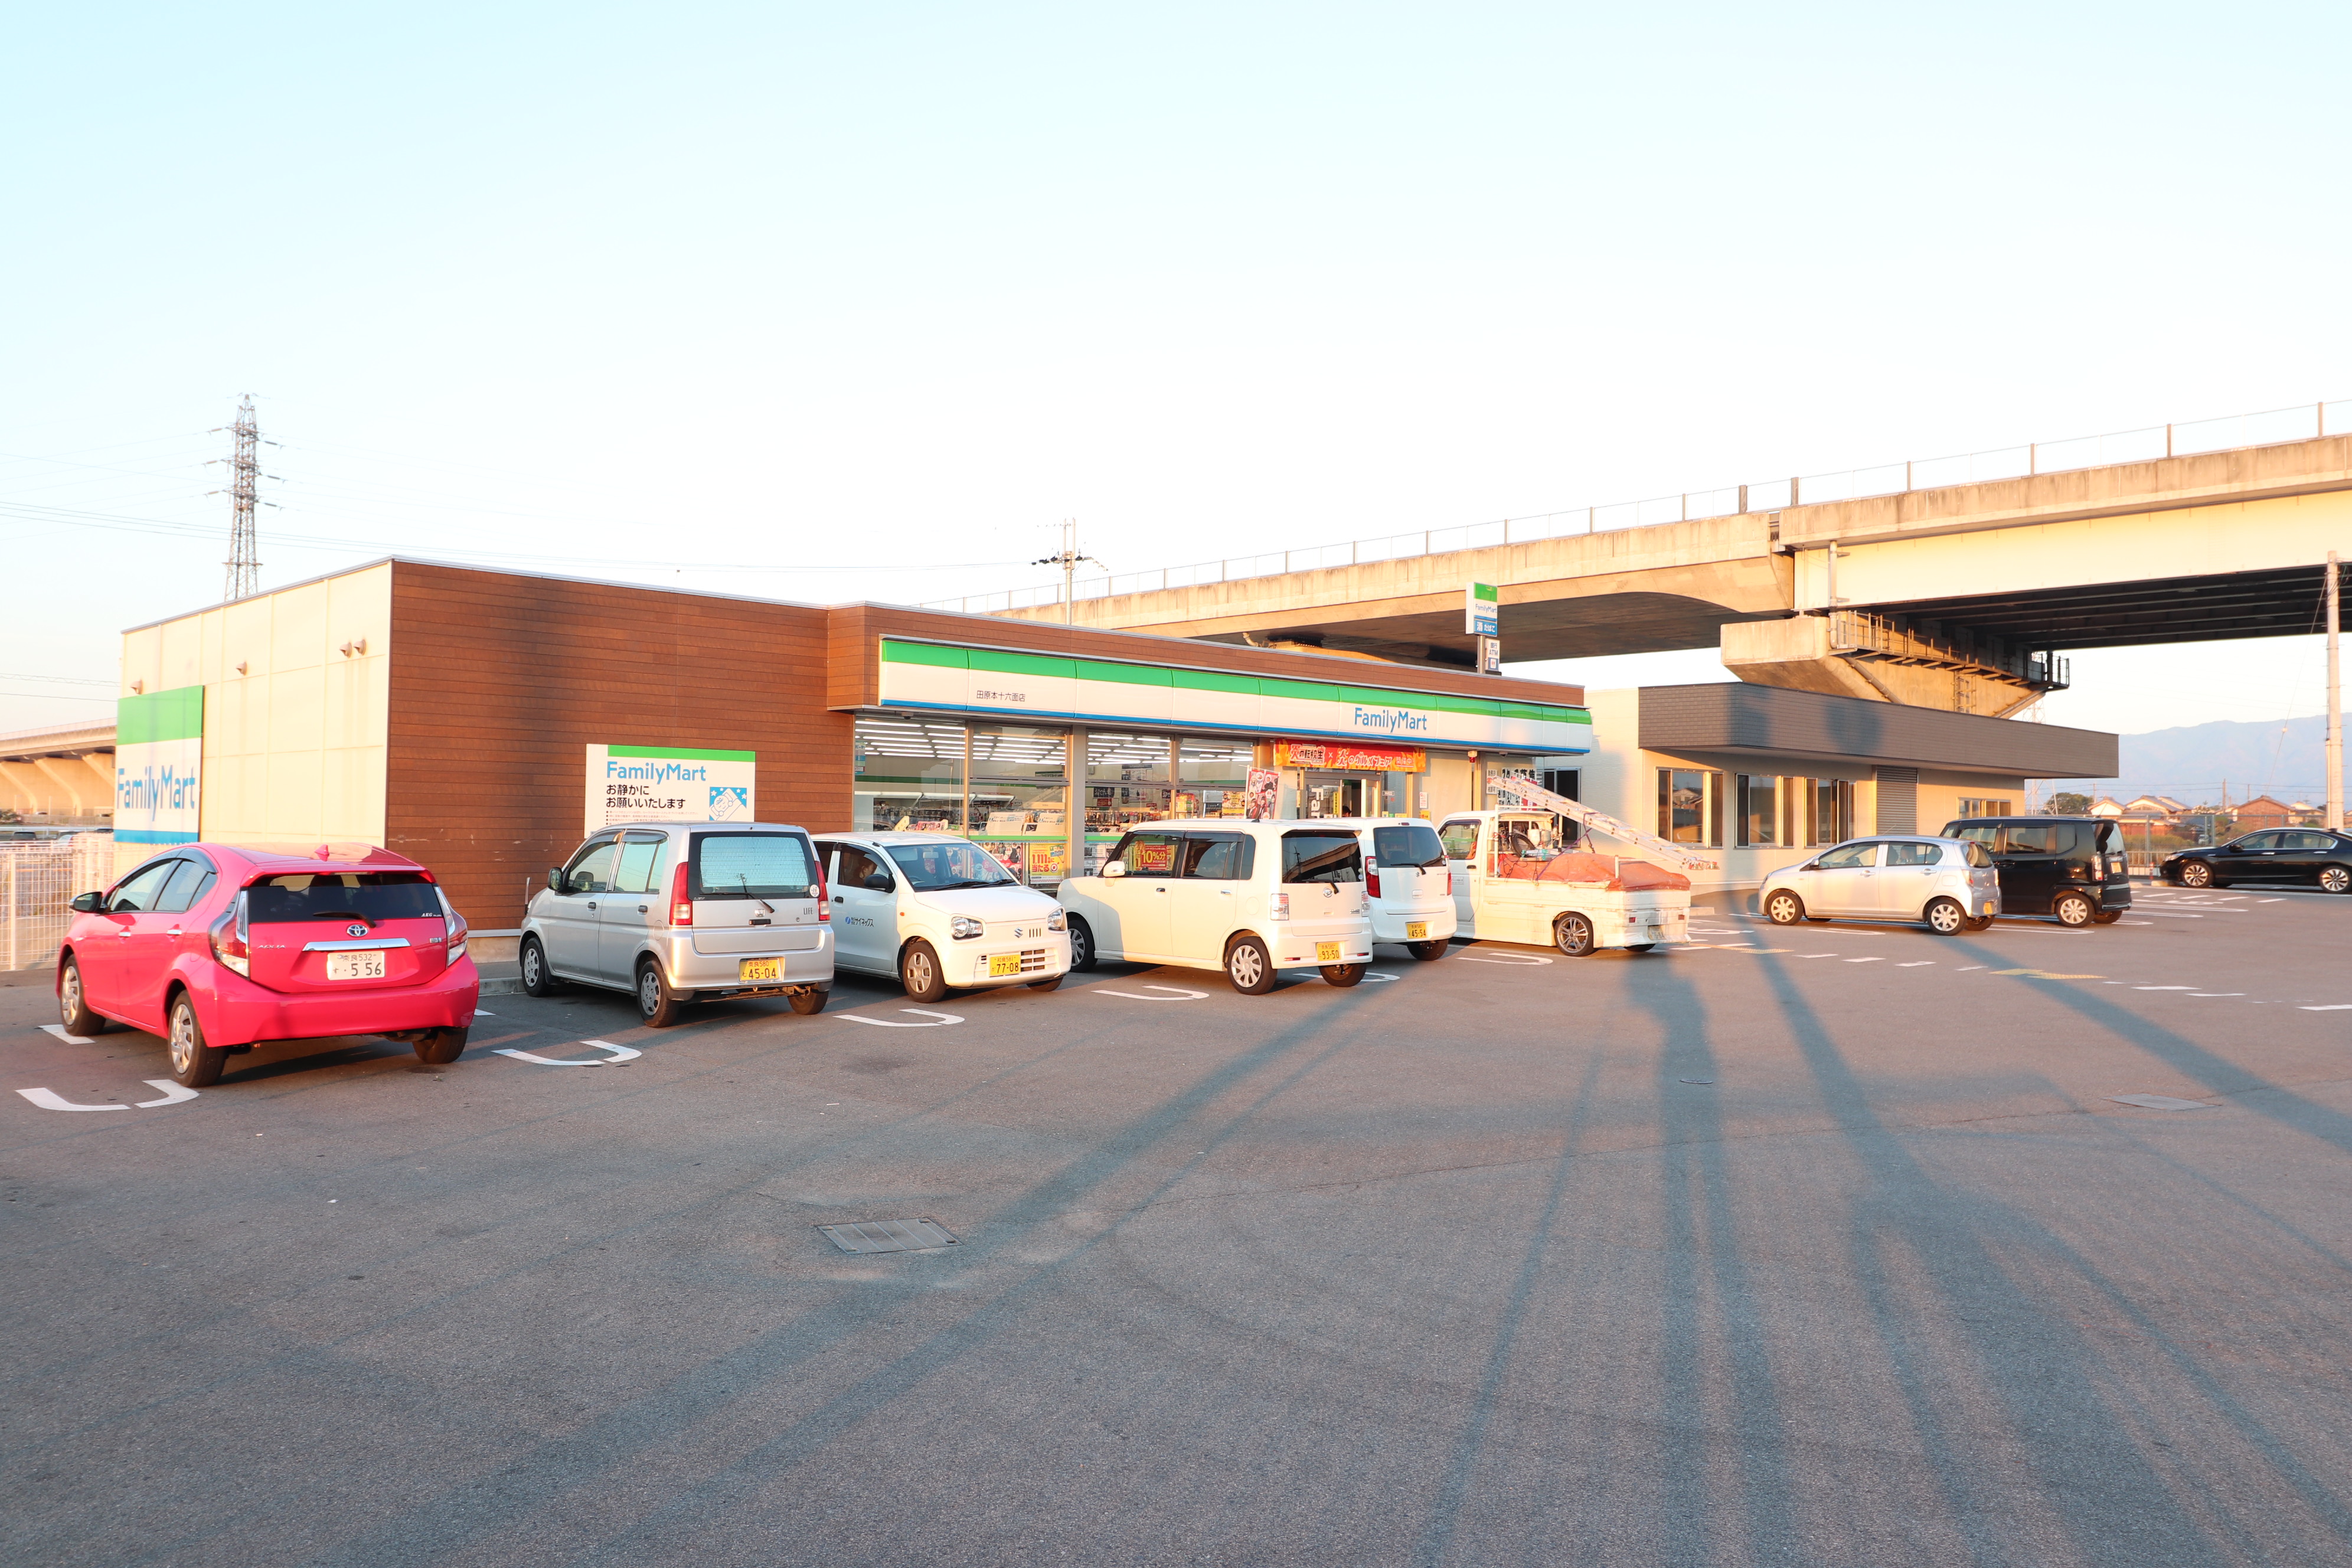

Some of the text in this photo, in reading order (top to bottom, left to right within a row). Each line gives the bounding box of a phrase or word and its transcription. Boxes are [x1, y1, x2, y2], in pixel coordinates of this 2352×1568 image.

[1475, 604, 1497, 613] FamilyMart
[1476, 622, 1495, 633] 酒 たばこ
[976, 690, 1025, 702] 田原本十六面店
[1354, 707, 1427, 733] FamilyMart
[1290, 744, 1324, 760] 炎の転校生
[1337, 749, 1393, 767] 炎のグルメフェア
[607, 761, 706, 785] FamilyMart
[116, 764, 195, 821] FamilyMart
[606, 784, 649, 795] お静かに
[606, 798, 685, 809] お願いいたします
[1032, 864, 1049, 873] 当たる
[1412, 929, 1426, 937] 45-54
[342, 953, 373, 962] 奈良532
[1322, 949, 1340, 960] 93-50
[749, 968, 776, 979] 45-04
[997, 962, 1019, 974] 77-08
